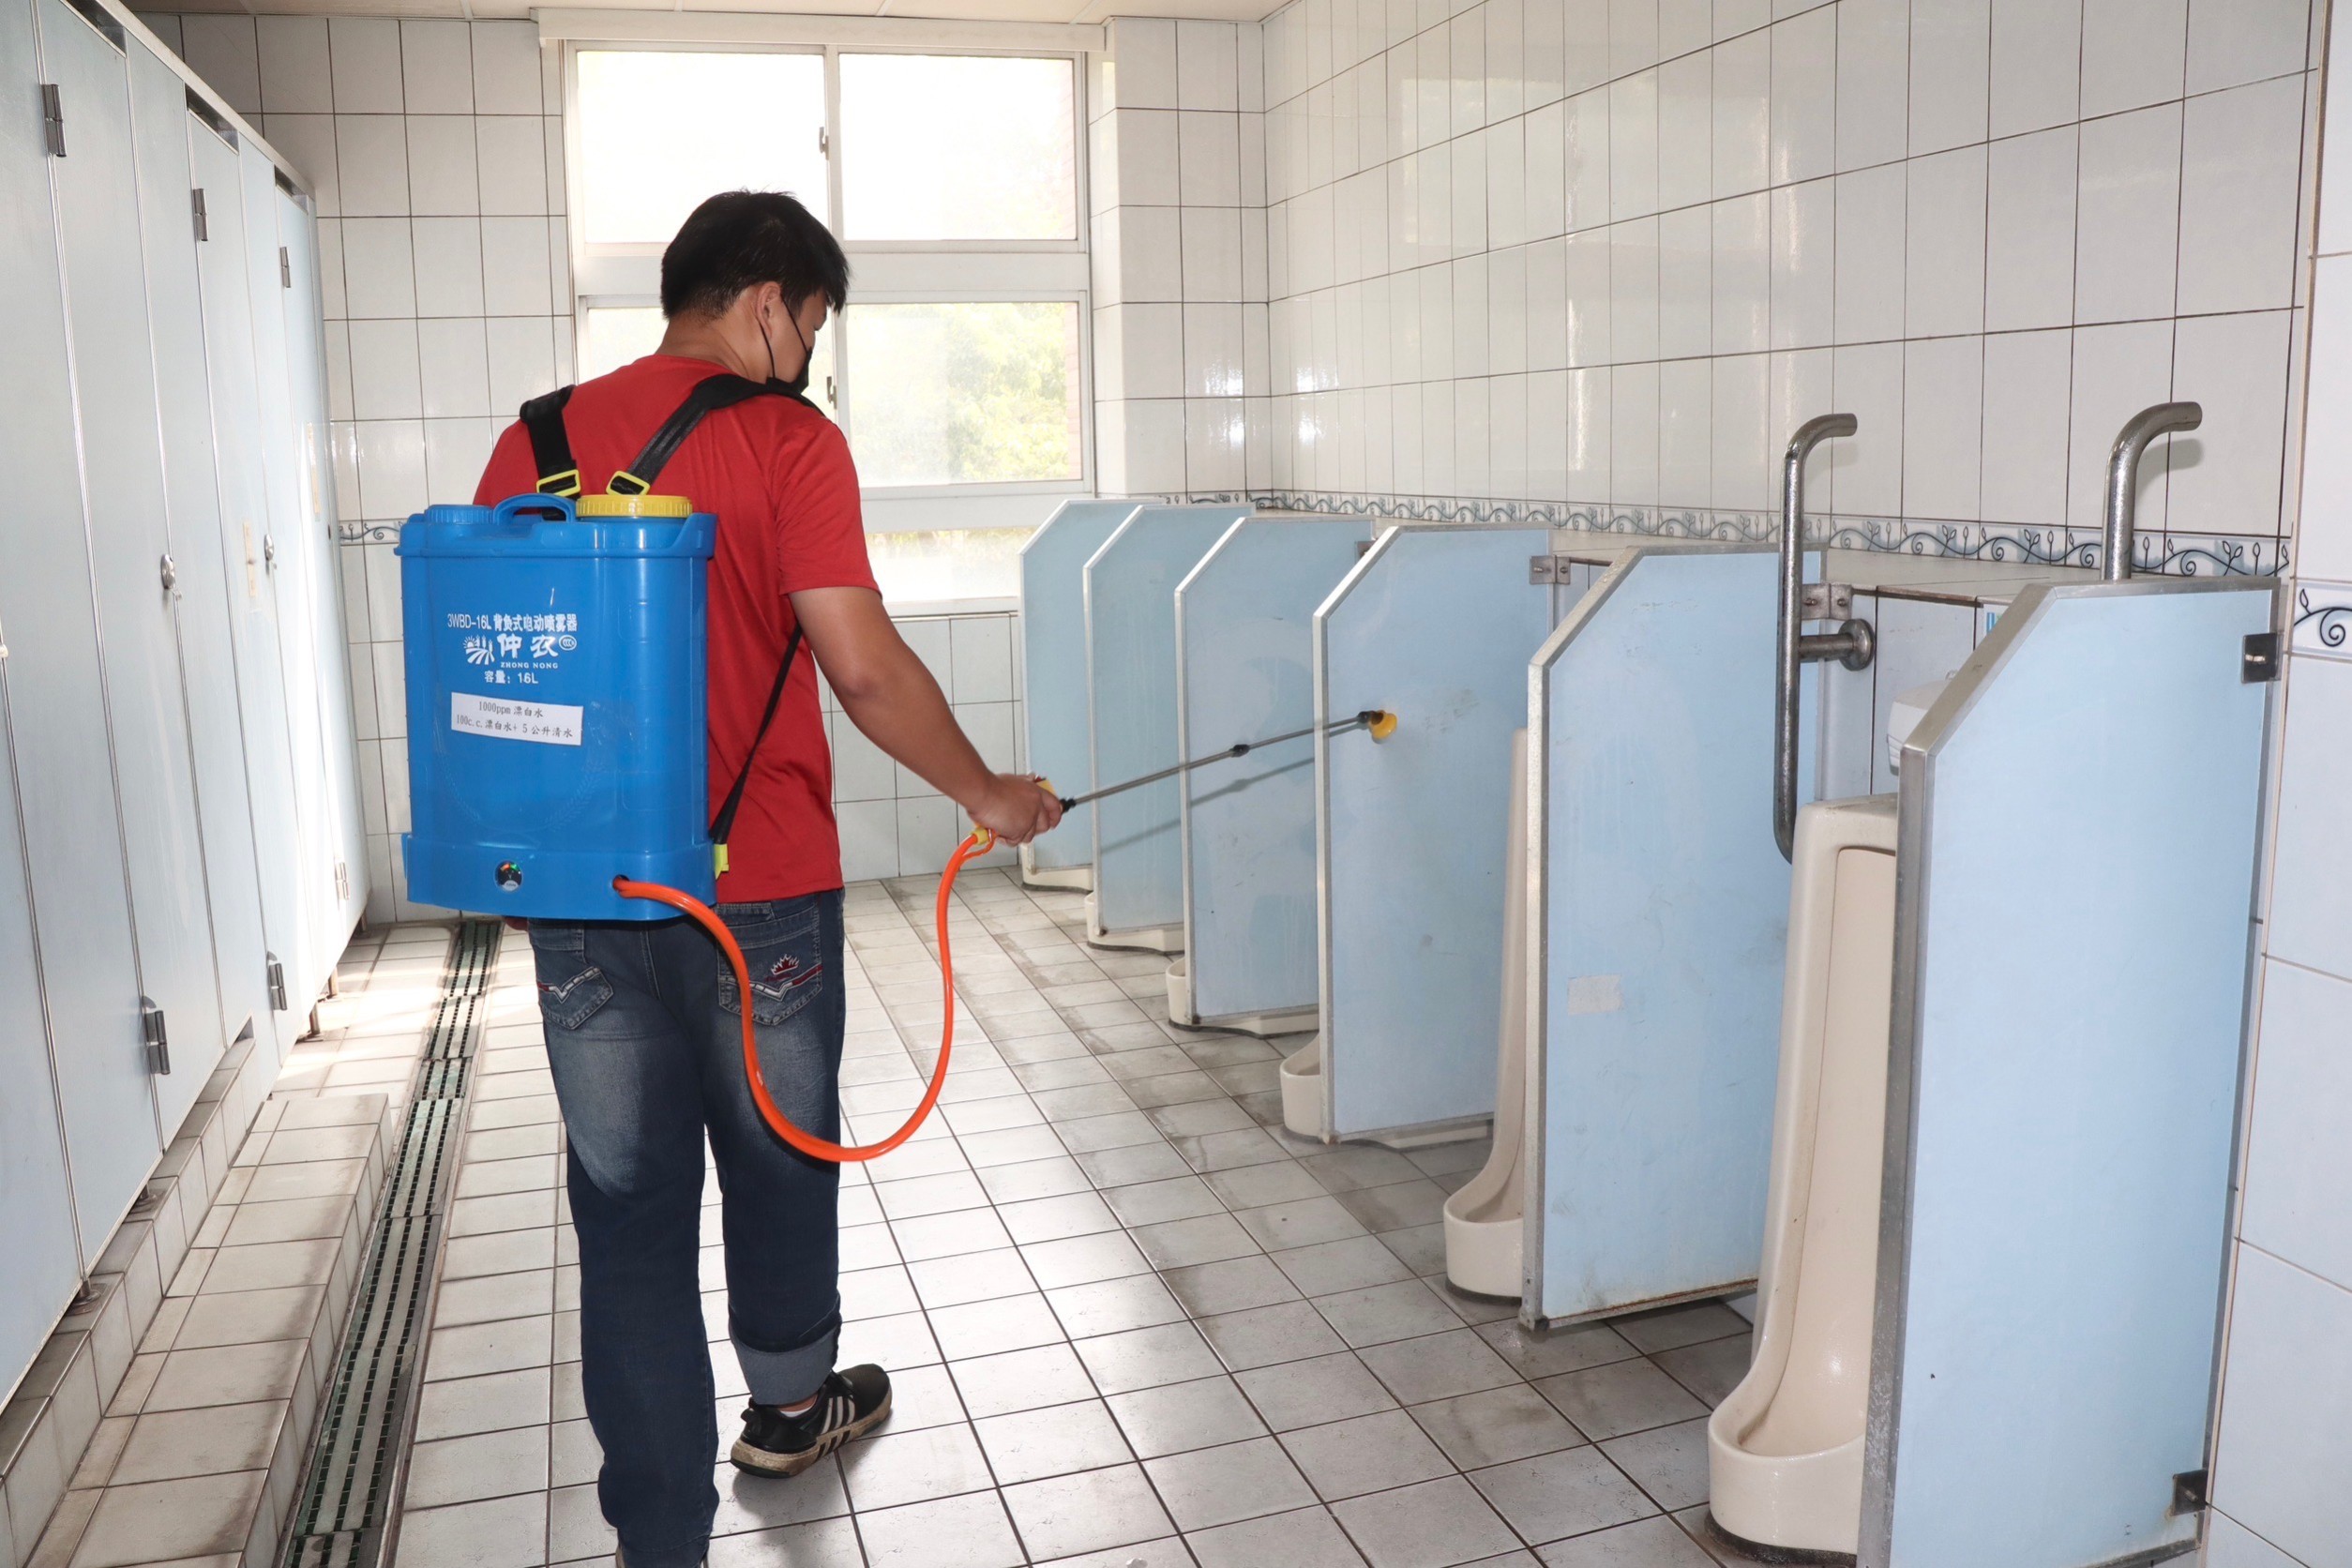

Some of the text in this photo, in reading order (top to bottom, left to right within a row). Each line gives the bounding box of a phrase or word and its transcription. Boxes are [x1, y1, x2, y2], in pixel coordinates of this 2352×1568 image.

[447, 613, 492, 630] 3WBD-16L
[517, 672, 539, 685] 16L
[479, 701, 511, 716] 1000ppm
